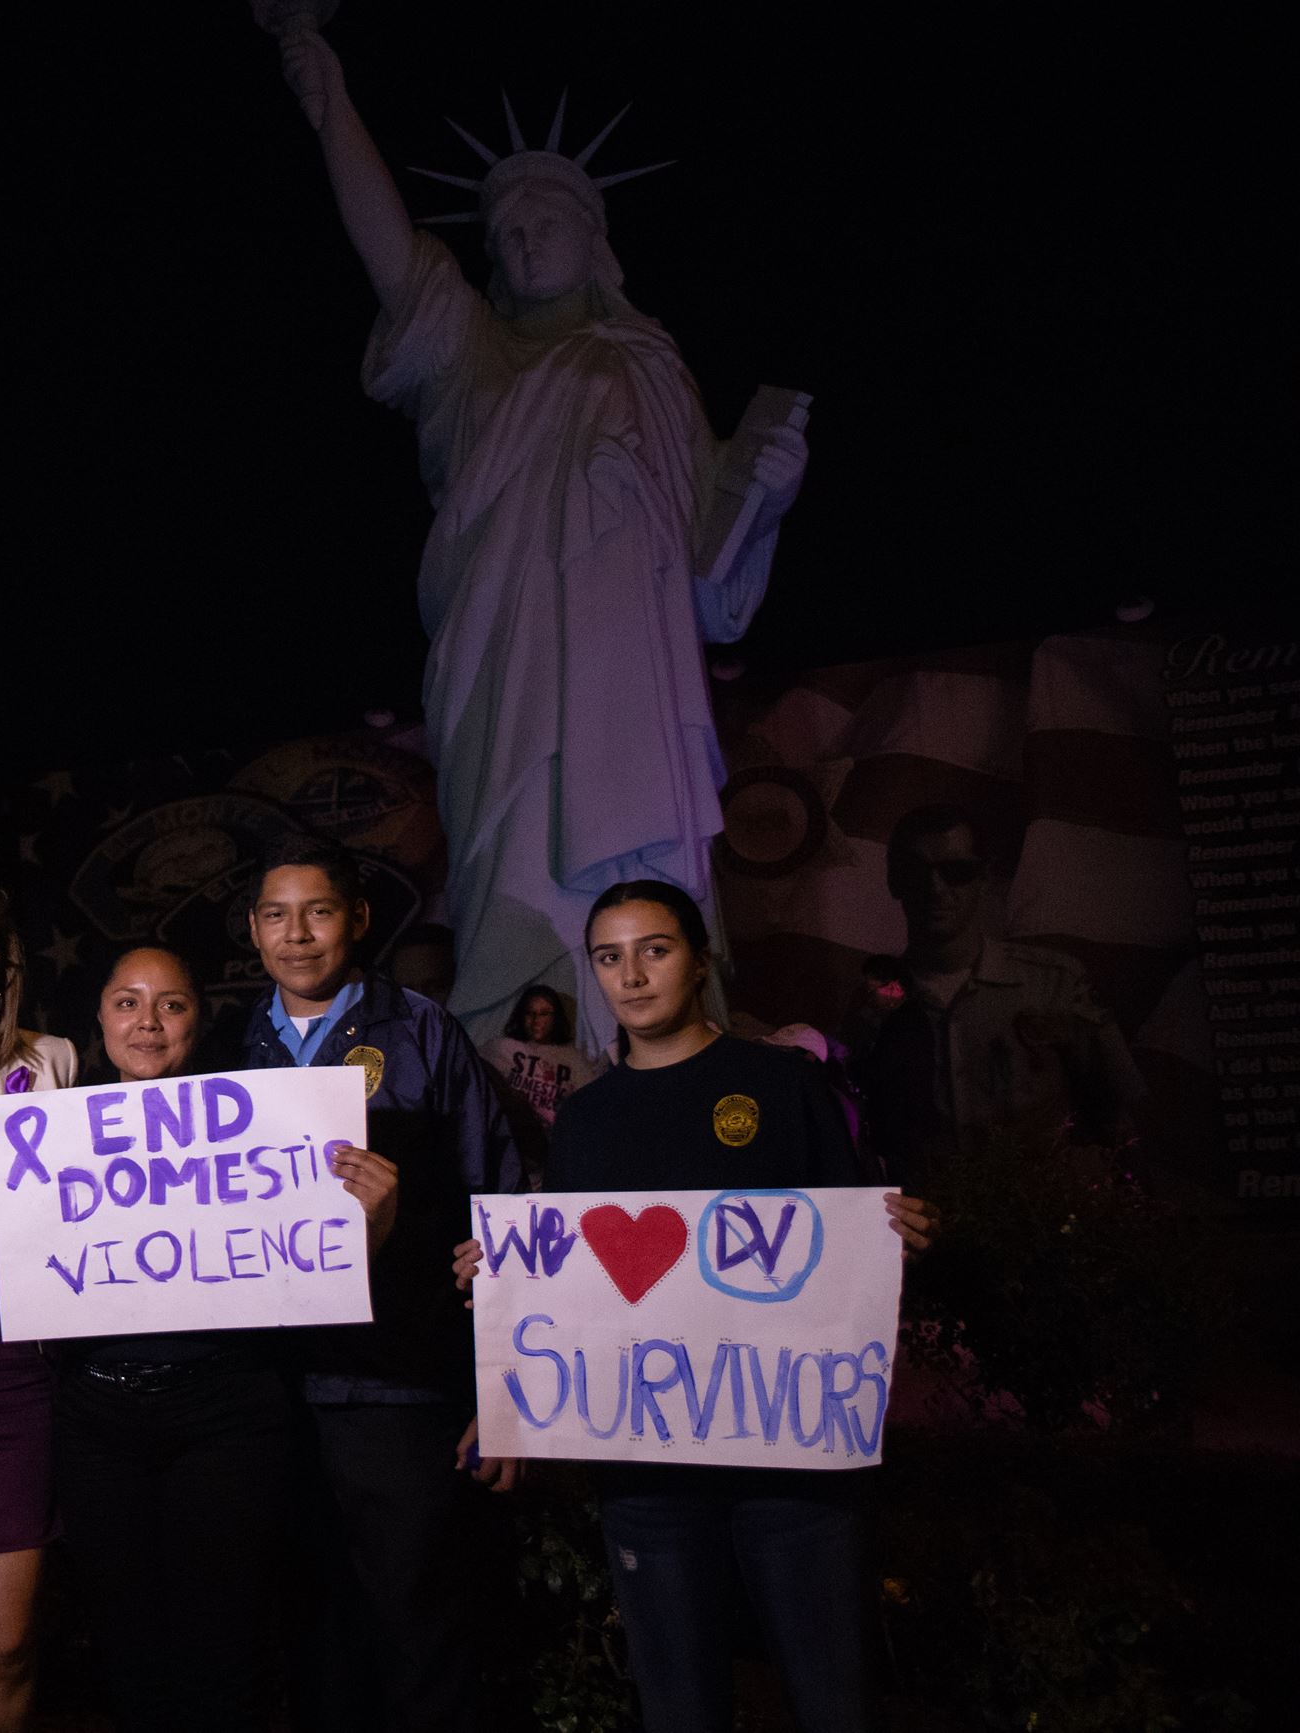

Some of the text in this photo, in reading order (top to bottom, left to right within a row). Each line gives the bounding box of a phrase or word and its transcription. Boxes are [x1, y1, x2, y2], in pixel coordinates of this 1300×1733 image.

[1165, 689, 1221, 707] When
[1226, 686, 1264, 704] you
[1171, 710, 1277, 734] Remember
[1173, 742, 1229, 760] When
[1232, 736, 1265, 753] the
[1178, 763, 1284, 785] Remember
[1179, 794, 1236, 812] When
[1240, 789, 1277, 808] you
[1187, 840, 1297, 862] Remember
[1189, 872, 1246, 889] When
[1251, 868, 1289, 886] you
[1196, 922, 1297, 942] When you
[1204, 980, 1262, 996] When
[1208, 1003, 1249, 1021] And
[1216, 1059, 1225, 1076] I
[86, 1077, 253, 1156] END
[1254, 1107, 1297, 1125] that
[715, 1198, 798, 1278] DV
[46, 1218, 353, 1295] VIOLENCE
[502, 1313, 890, 1458] SURVIVORS
